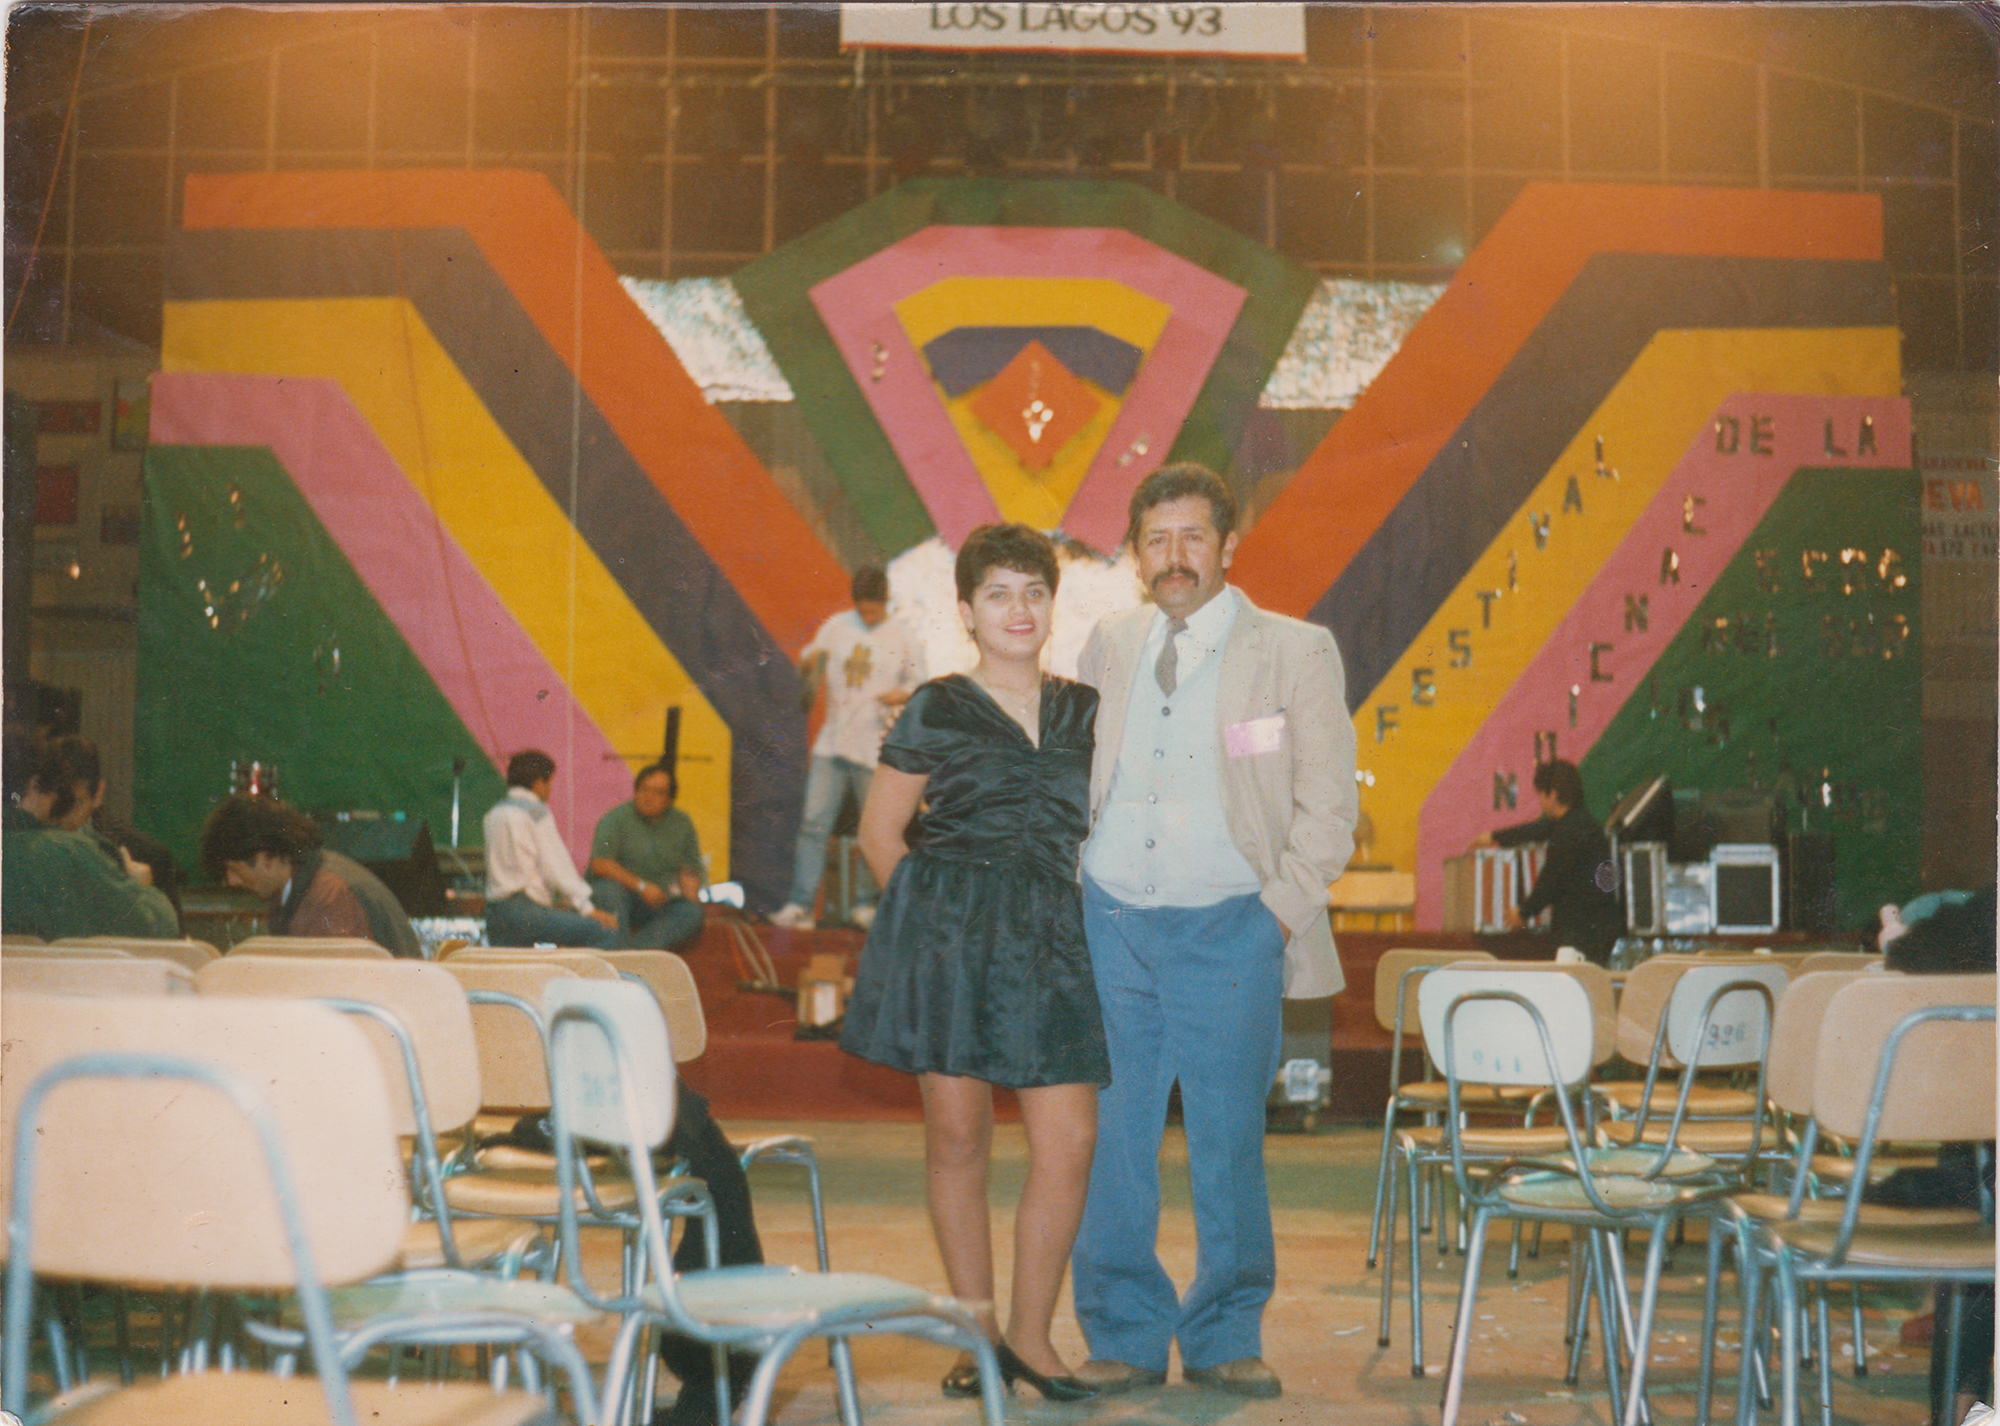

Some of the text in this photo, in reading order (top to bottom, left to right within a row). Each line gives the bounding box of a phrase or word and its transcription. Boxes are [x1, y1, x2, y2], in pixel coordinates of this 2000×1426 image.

[931, 3, 1005, 31] LOS
[1019, 3, 1157, 35] LAGOS
[1714, 414, 1879, 457] DE LA
[1920, 478, 1984, 513] EVA
[1375, 434, 1620, 744] FESTIVAL
